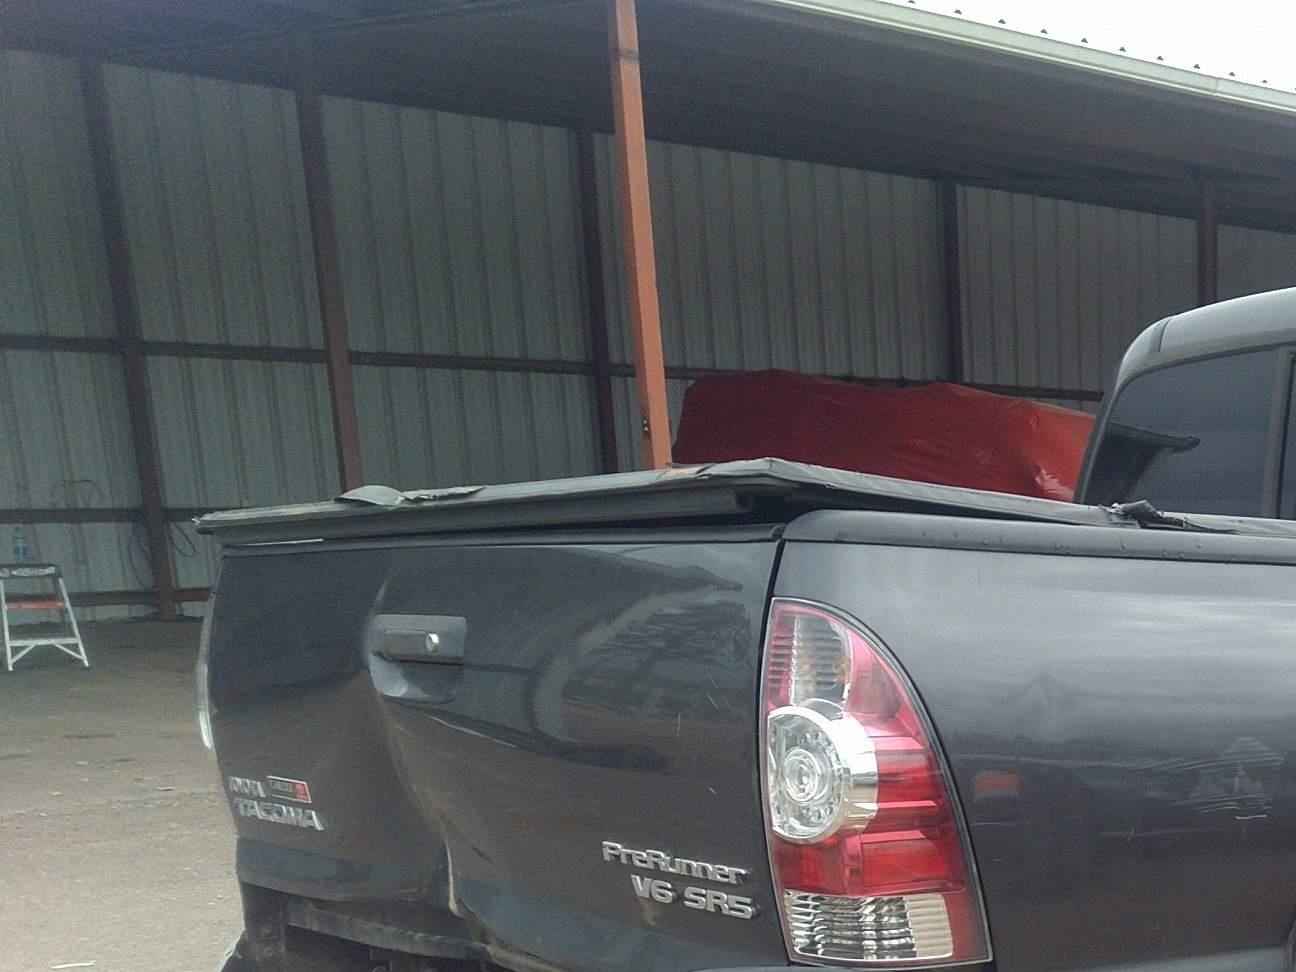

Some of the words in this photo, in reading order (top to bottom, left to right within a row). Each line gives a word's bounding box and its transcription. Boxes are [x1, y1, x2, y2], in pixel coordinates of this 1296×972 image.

[601, 841, 750, 884] PreRunner
[630, 874, 674, 904] V6
[683, 886, 754, 920] SR5
